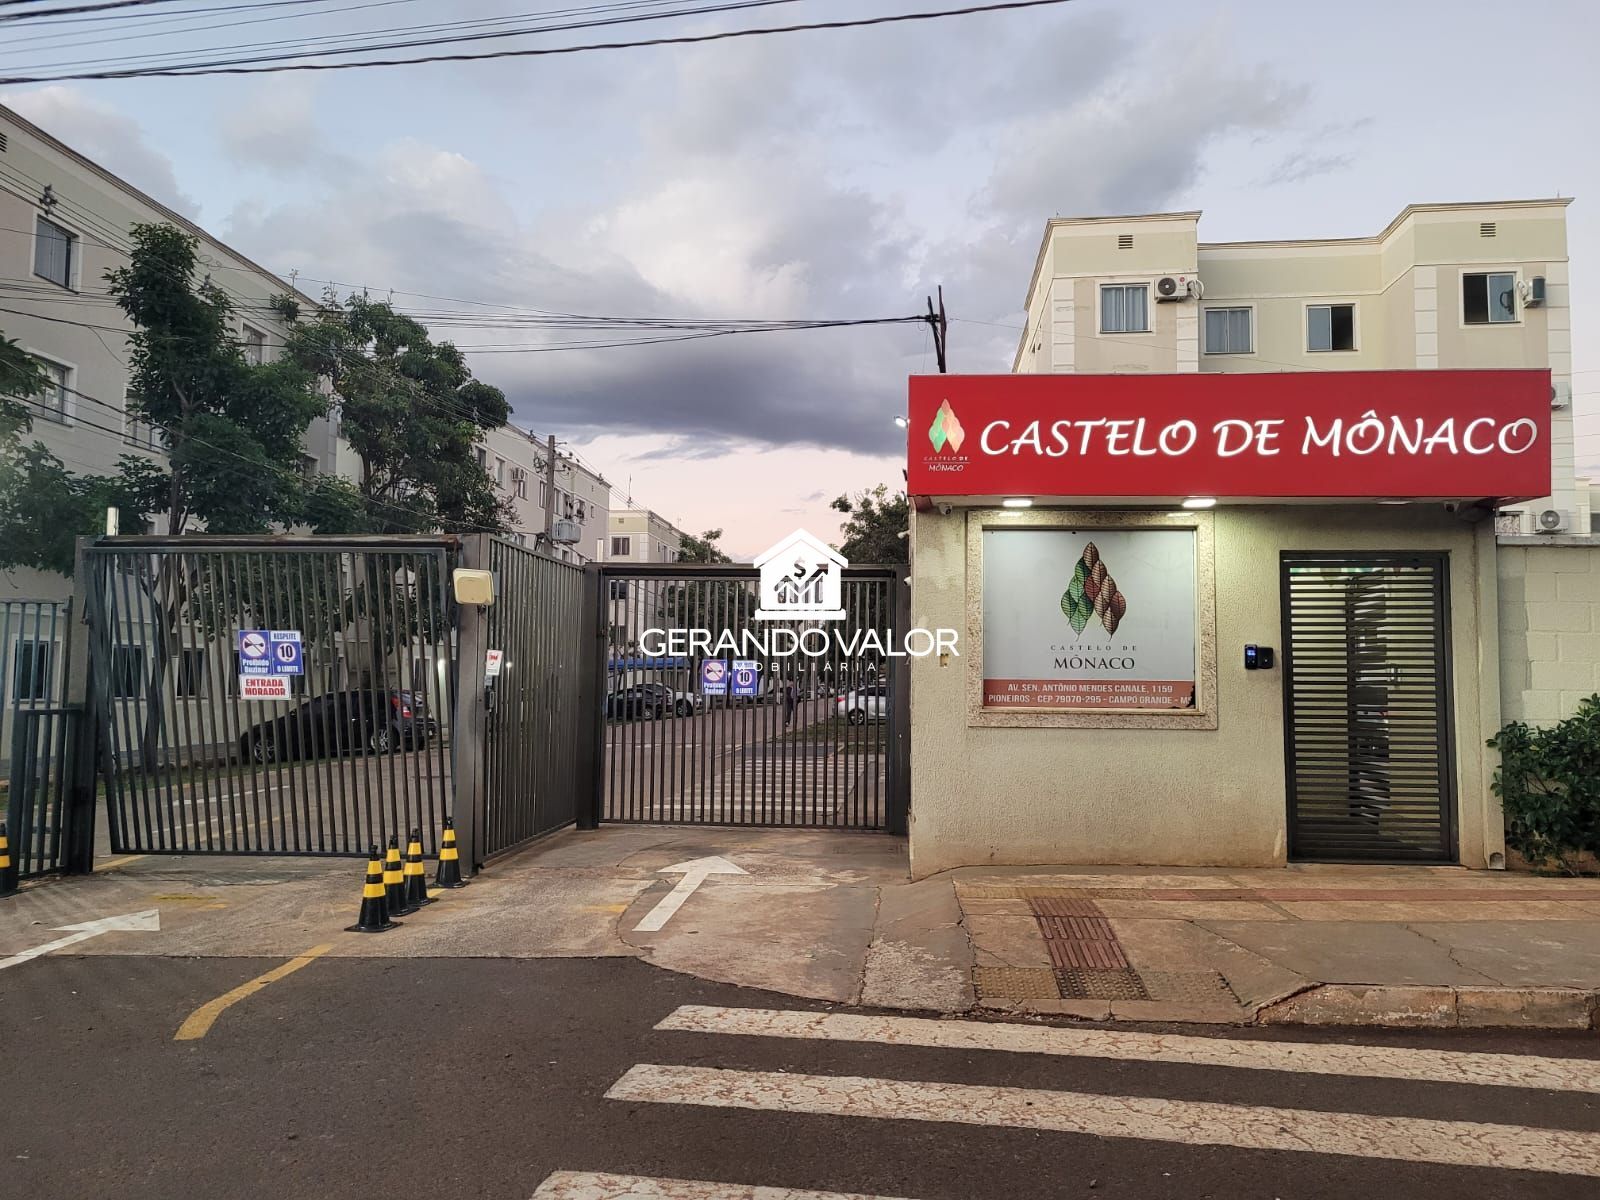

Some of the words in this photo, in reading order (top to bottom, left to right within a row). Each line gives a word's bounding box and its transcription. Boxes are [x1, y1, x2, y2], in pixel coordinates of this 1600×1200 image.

[979, 418, 1198, 457] CASTELO
[1213, 418, 1285, 458] DE
[1301, 410, 1538, 457] MÔNACO
[280, 645, 293, 658] 10
[1054, 654, 1135, 670] MÔNACO
[245, 678, 284, 687] ENTRADA
[740, 671, 750, 683] 10
[244, 687, 286, 696] MORADOR
[1007, 683, 1020, 691] AV.
[1021, 683, 1040, 692] SEN.
[1079, 684, 1113, 693] MENDES
[1152, 685, 1173, 693] 1159
[988, 694, 1030, 703] PIONEIROS
[1037, 695, 1053, 703] CEP
[1055, 695, 1101, 704] 79070-295
[1109, 695, 1138, 704] CAMPO
[1139, 696, 1173, 704] GRANDE
